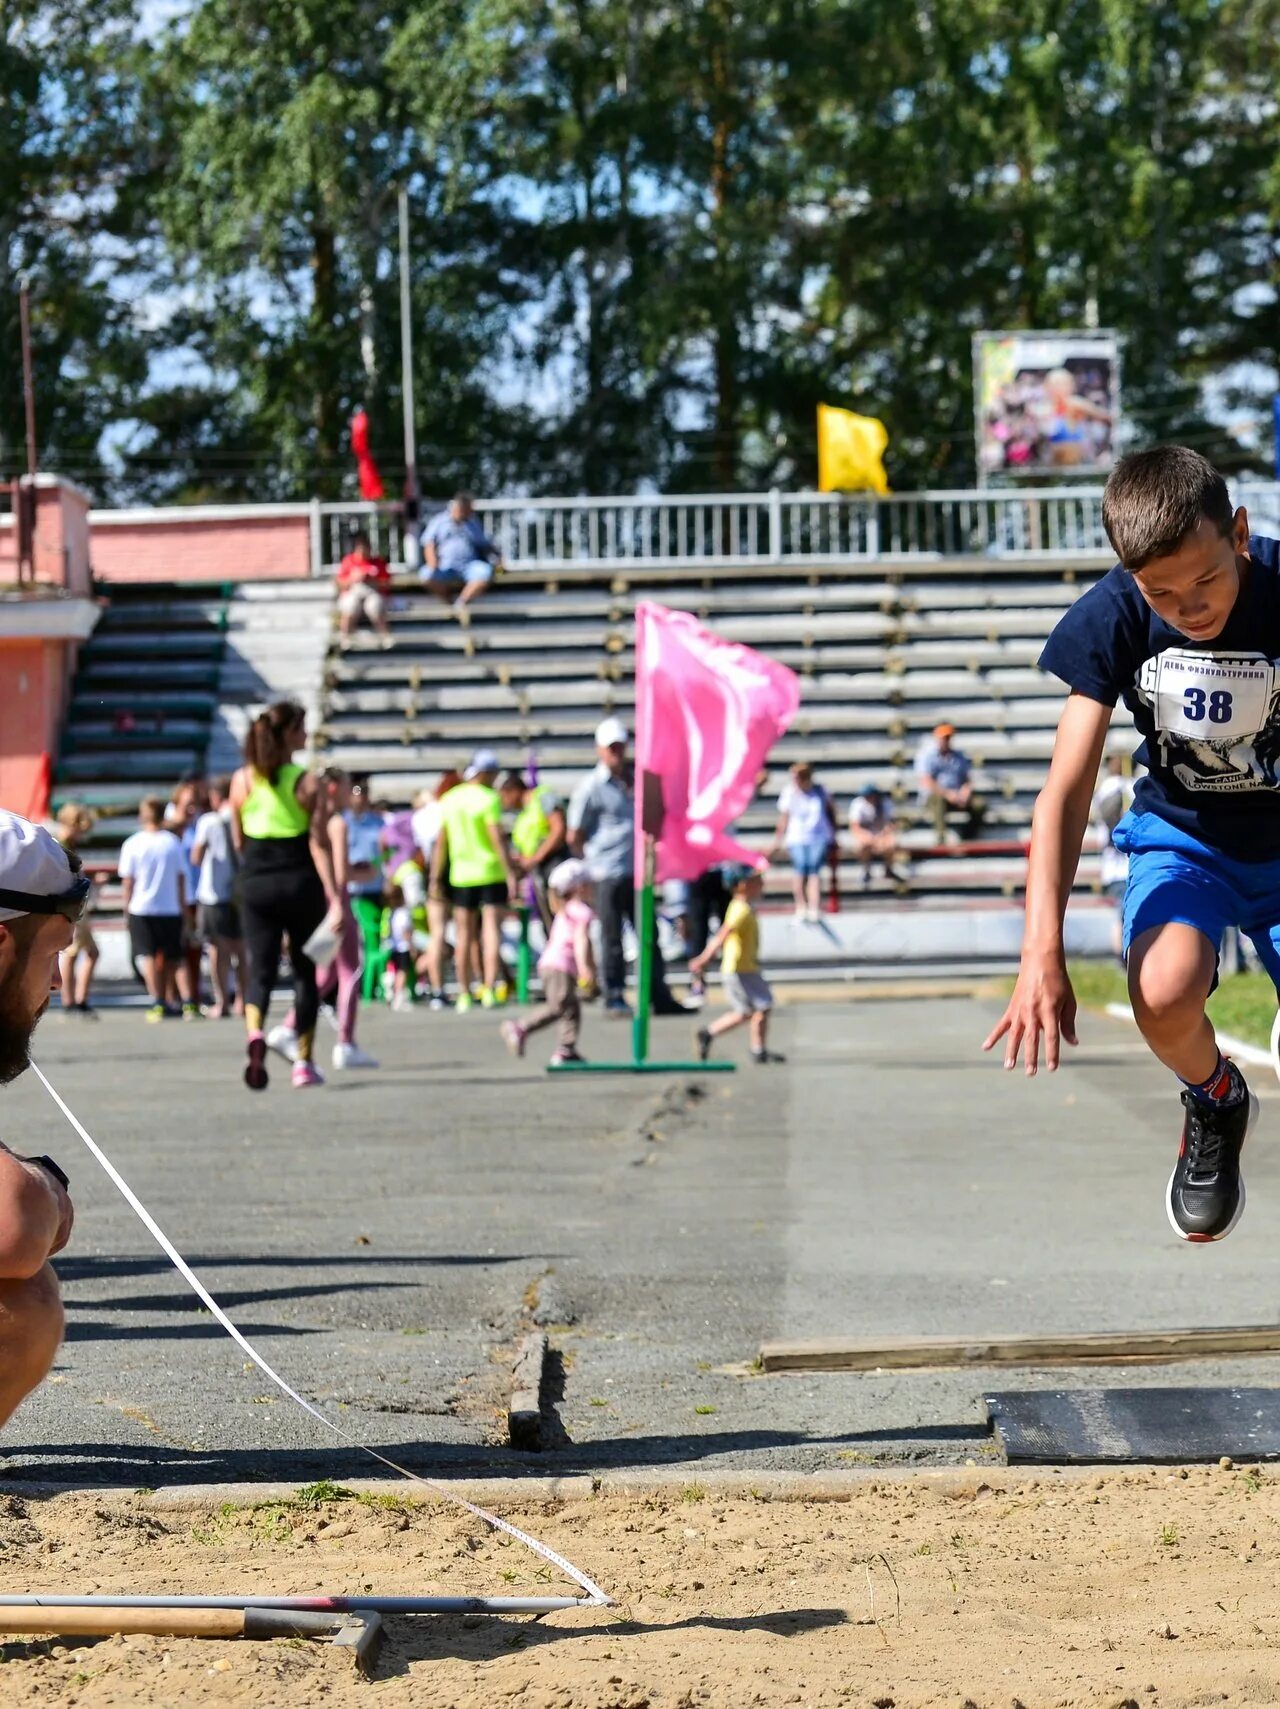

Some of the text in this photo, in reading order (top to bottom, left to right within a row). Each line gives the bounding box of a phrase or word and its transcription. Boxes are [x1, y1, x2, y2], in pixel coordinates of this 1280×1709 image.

[1164, 660, 1265, 679] ДЕНЬ ФИЗКУЛЬТУРНИКА
[1183, 687, 1233, 723] 38
[1214, 773, 1246, 784] CANIS
